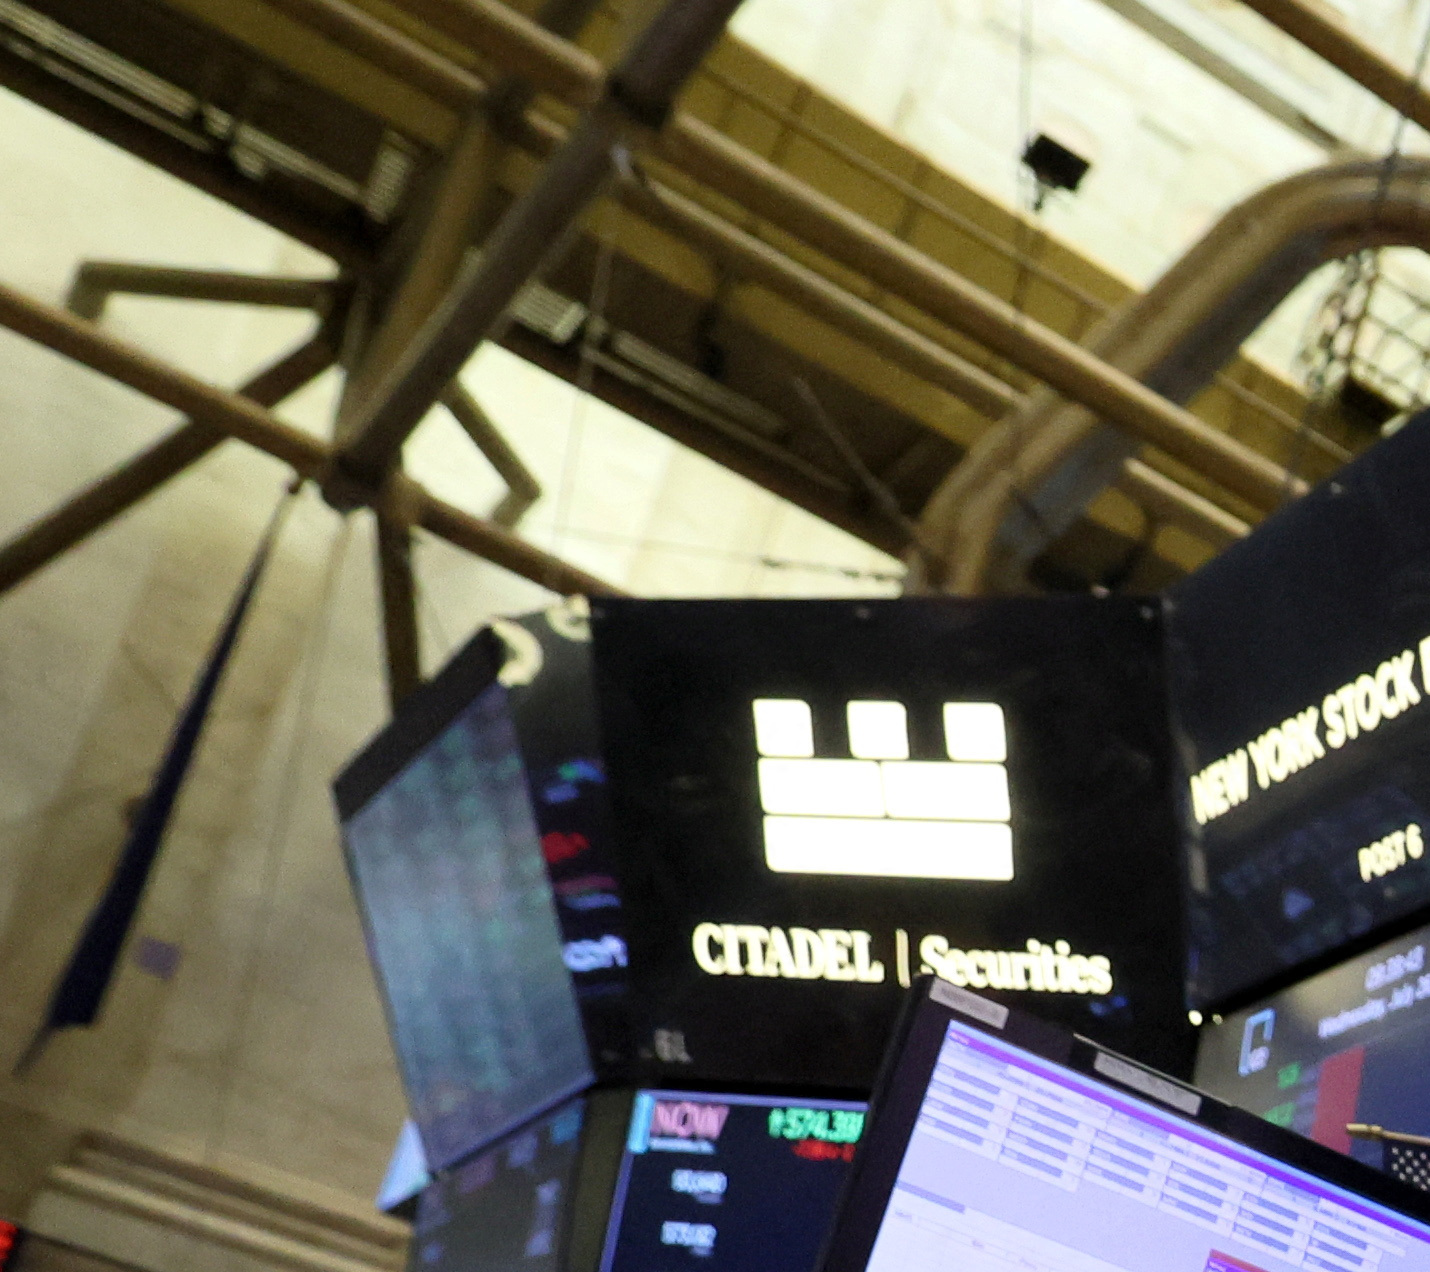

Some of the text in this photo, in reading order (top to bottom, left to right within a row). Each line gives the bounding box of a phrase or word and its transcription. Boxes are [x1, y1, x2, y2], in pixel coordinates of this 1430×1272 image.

[1190, 749, 1249, 824] NEW
[1247, 707, 1325, 789] YORK
[1323, 650, 1421, 748] STOCK
[1358, 823, 1424, 882] POST 6
[693, 923, 1113, 994] CITADEL Securities
